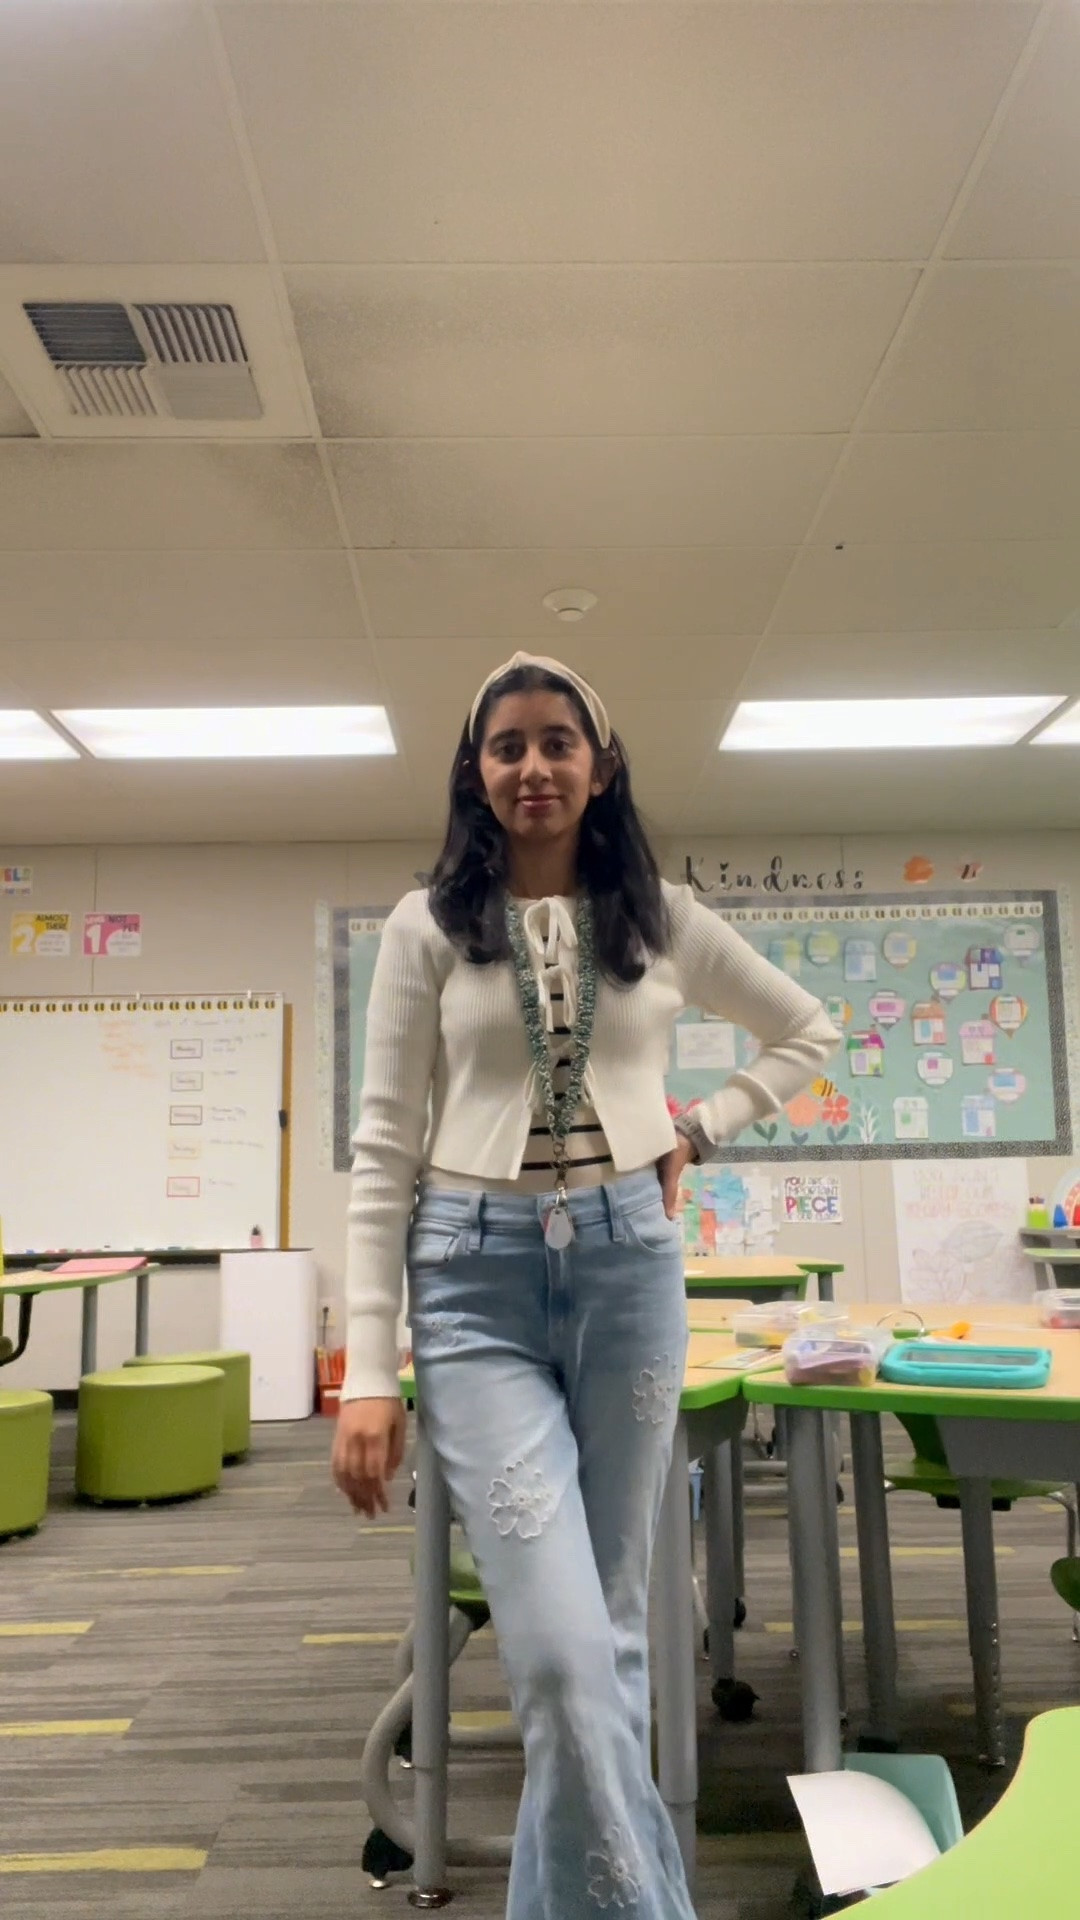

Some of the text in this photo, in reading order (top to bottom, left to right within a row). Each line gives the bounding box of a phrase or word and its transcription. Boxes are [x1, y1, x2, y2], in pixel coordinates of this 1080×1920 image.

[685, 855, 864, 892] Kindness
[86, 924, 102, 954] 1
[785, 1196, 839, 1214] PIECE
